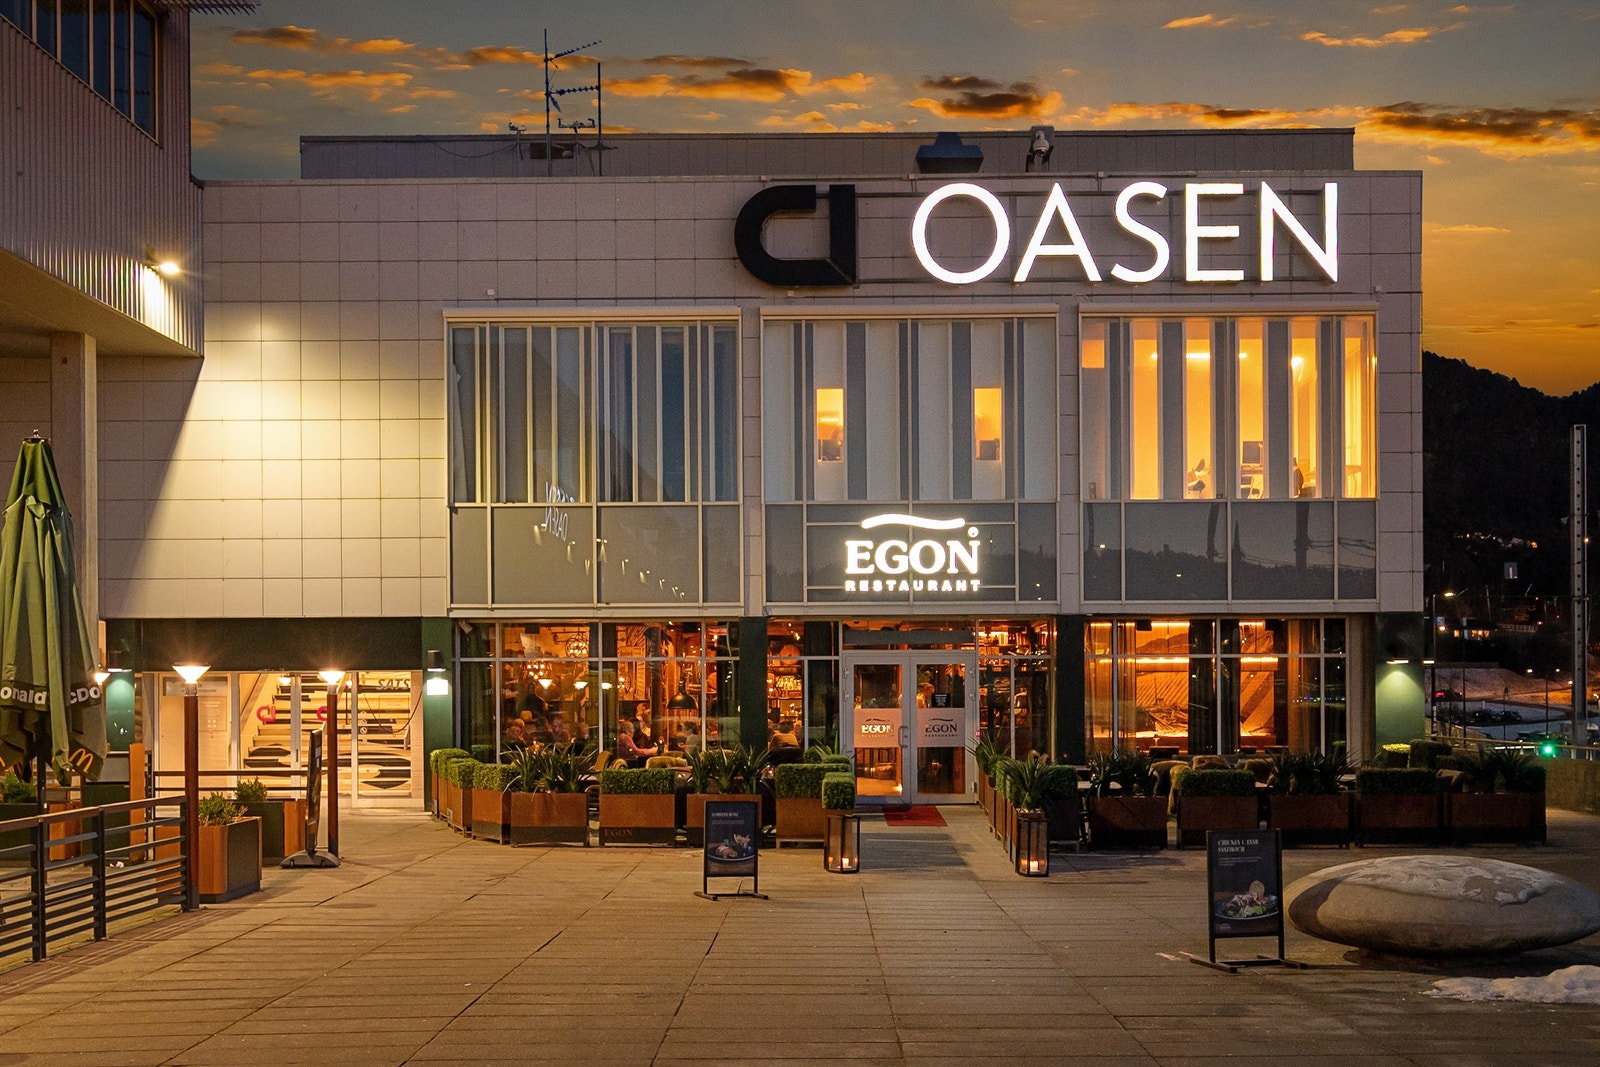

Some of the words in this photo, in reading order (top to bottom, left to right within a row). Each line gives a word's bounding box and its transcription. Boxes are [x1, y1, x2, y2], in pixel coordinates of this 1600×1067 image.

[911, 181, 1338, 284] OASEN
[845, 539, 980, 574] EGON
[845, 580, 982, 592] RESTAURANT
[376, 678, 411, 690] SATS
[925, 723, 958, 733] EGON
